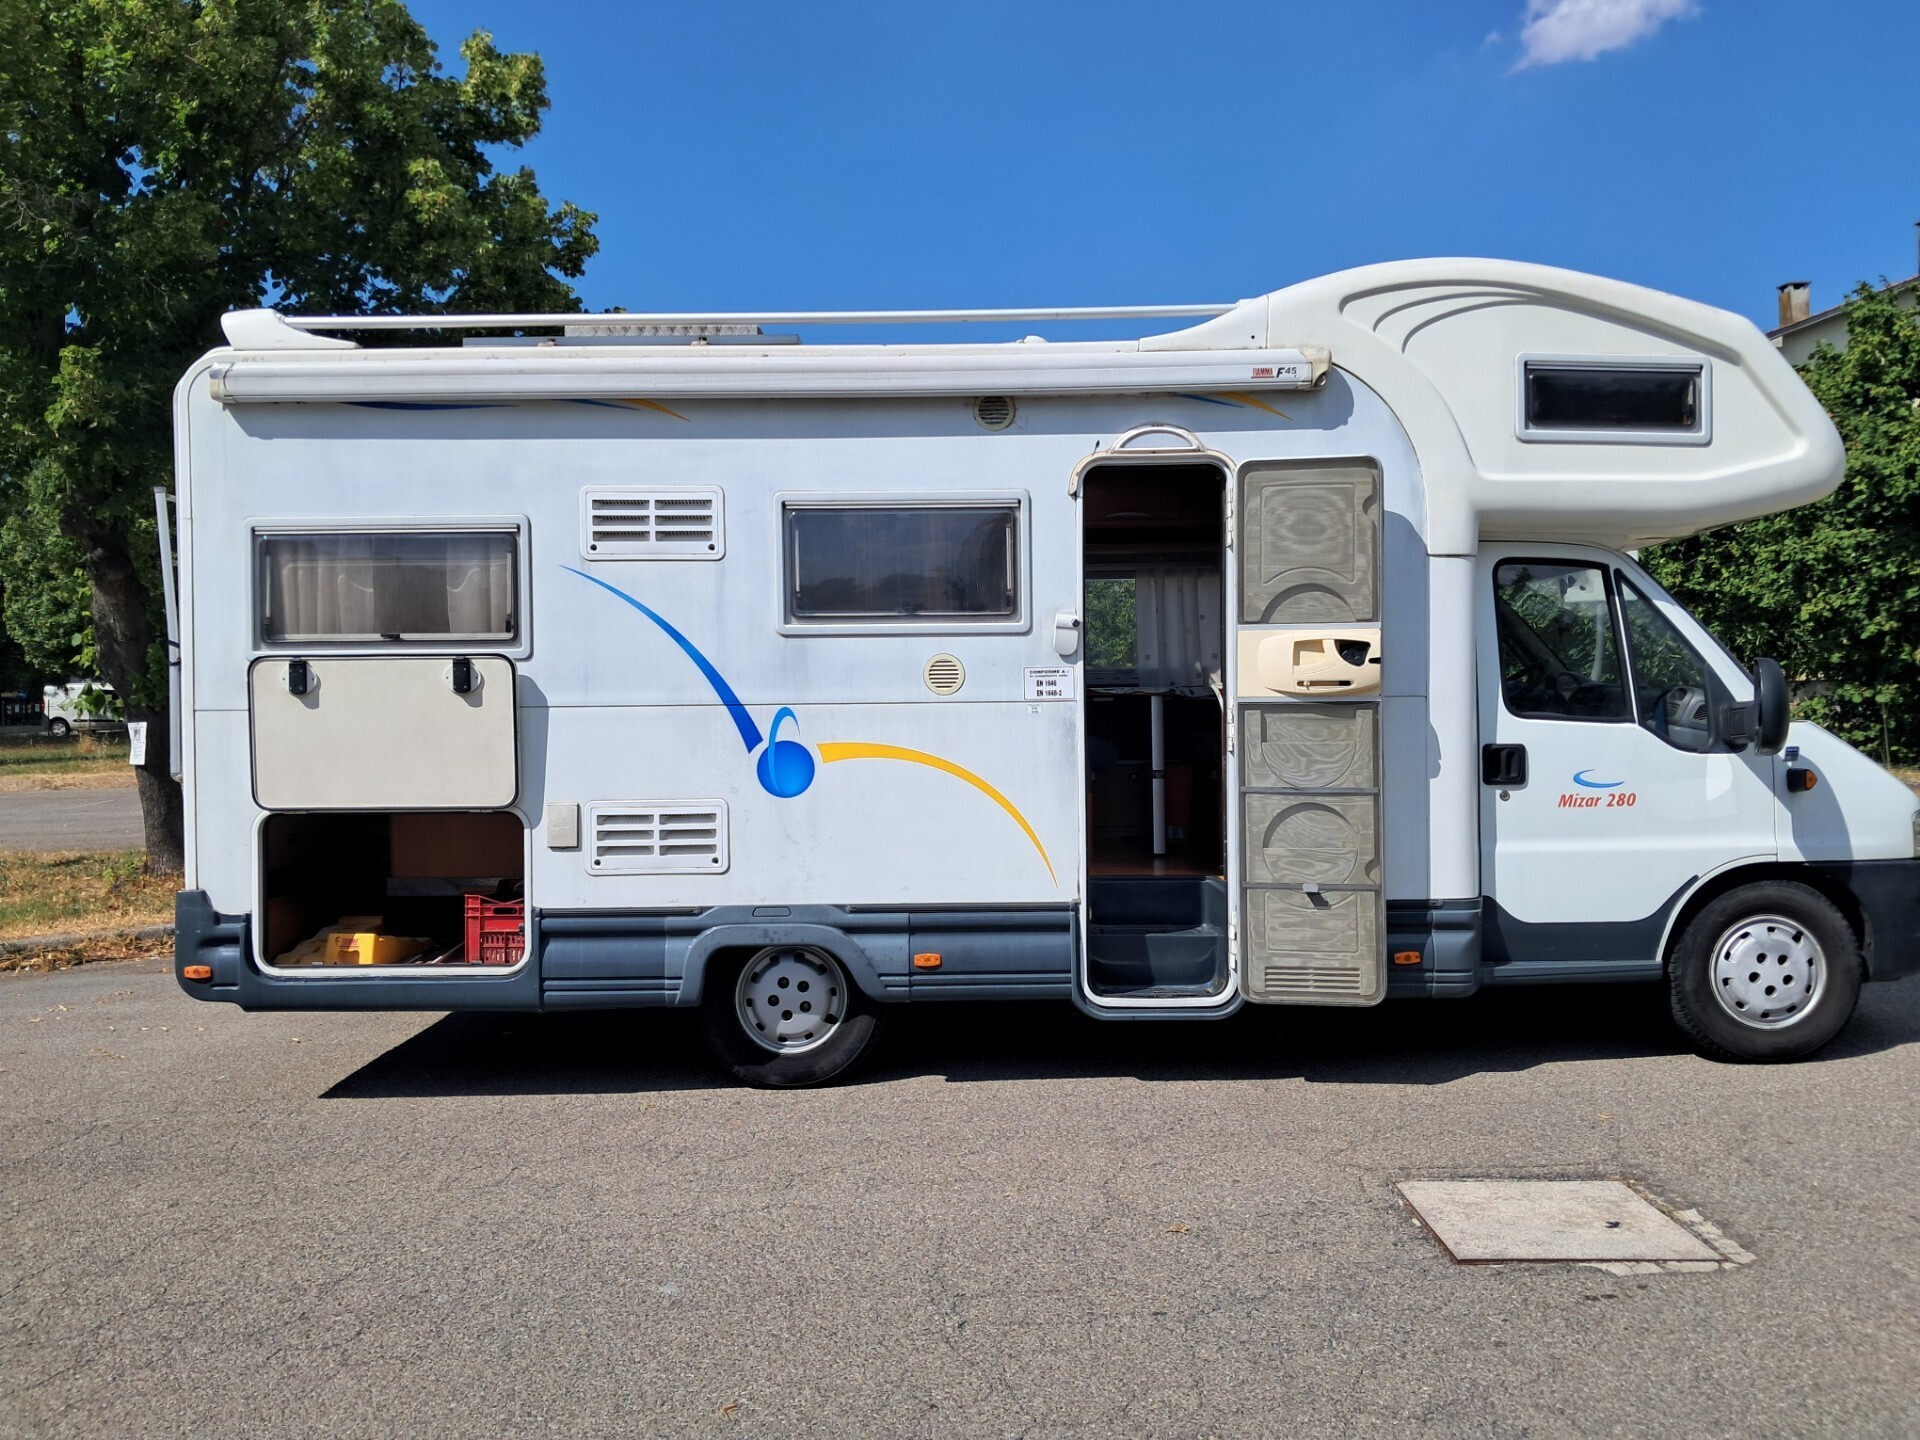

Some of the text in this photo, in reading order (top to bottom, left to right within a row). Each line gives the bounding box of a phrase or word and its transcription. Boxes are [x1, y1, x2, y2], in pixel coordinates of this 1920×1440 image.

[1252, 367, 1273, 377] FIAMMA
[1558, 792, 1637, 808] Mizar 280
